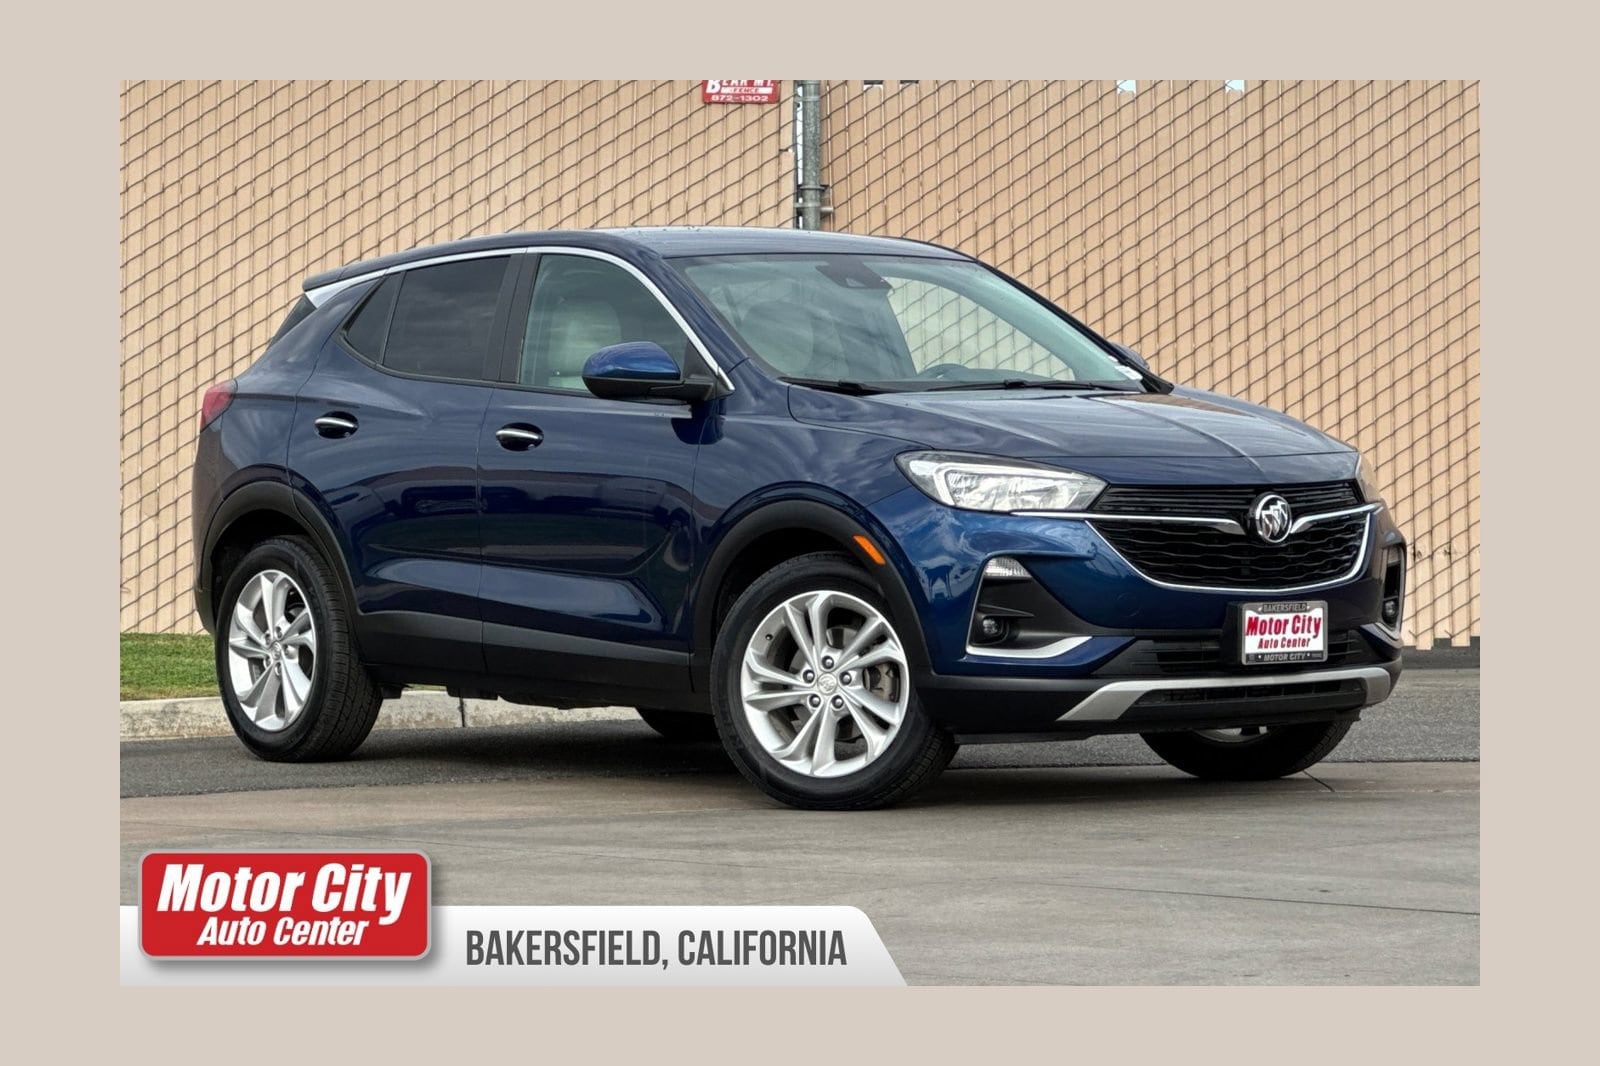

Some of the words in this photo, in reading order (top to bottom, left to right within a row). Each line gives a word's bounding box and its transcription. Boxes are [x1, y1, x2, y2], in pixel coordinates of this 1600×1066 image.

[1263, 604, 1307, 612] BAKERSFIELD
[1245, 616, 1289, 636] Motor
[1291, 614, 1322, 639] City
[1257, 638, 1279, 649] Auto
[1280, 637, 1311, 649] Center
[1263, 654, 1288, 662] MOTOR
[1289, 653, 1305, 661] CITY
